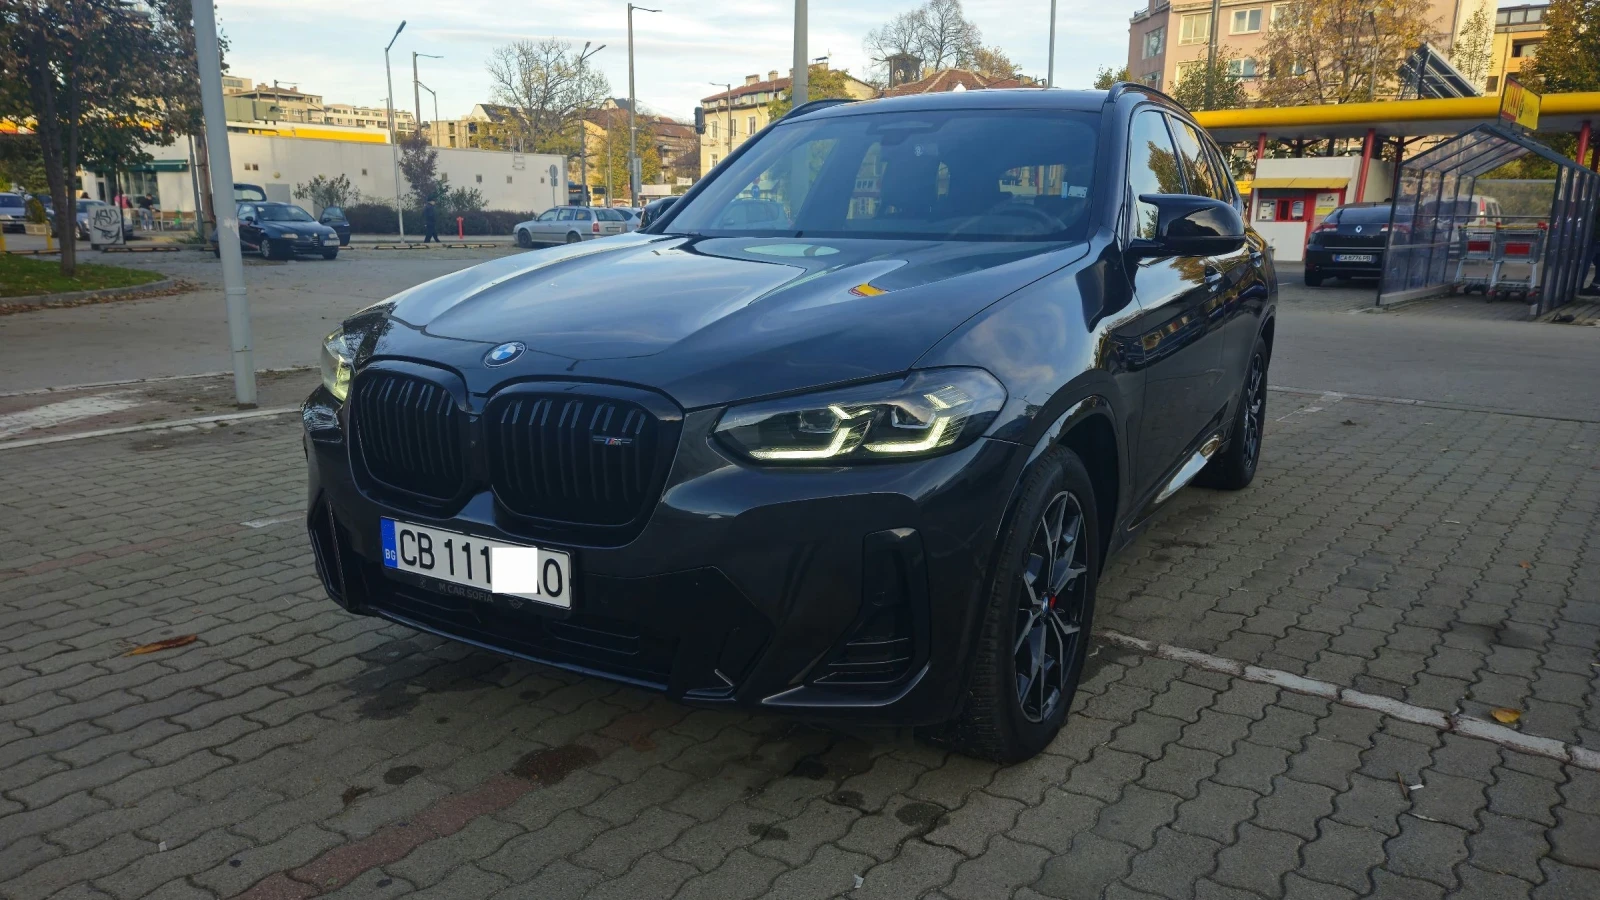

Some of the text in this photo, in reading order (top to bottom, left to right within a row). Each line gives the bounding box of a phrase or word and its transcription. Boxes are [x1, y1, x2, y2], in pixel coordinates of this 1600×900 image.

[385, 548, 396, 560] BG
[400, 529, 435, 570] CB
[444, 538, 491, 584] 111
[447, 585, 465, 596] CAR
[466, 589, 494, 602] SOFIA
